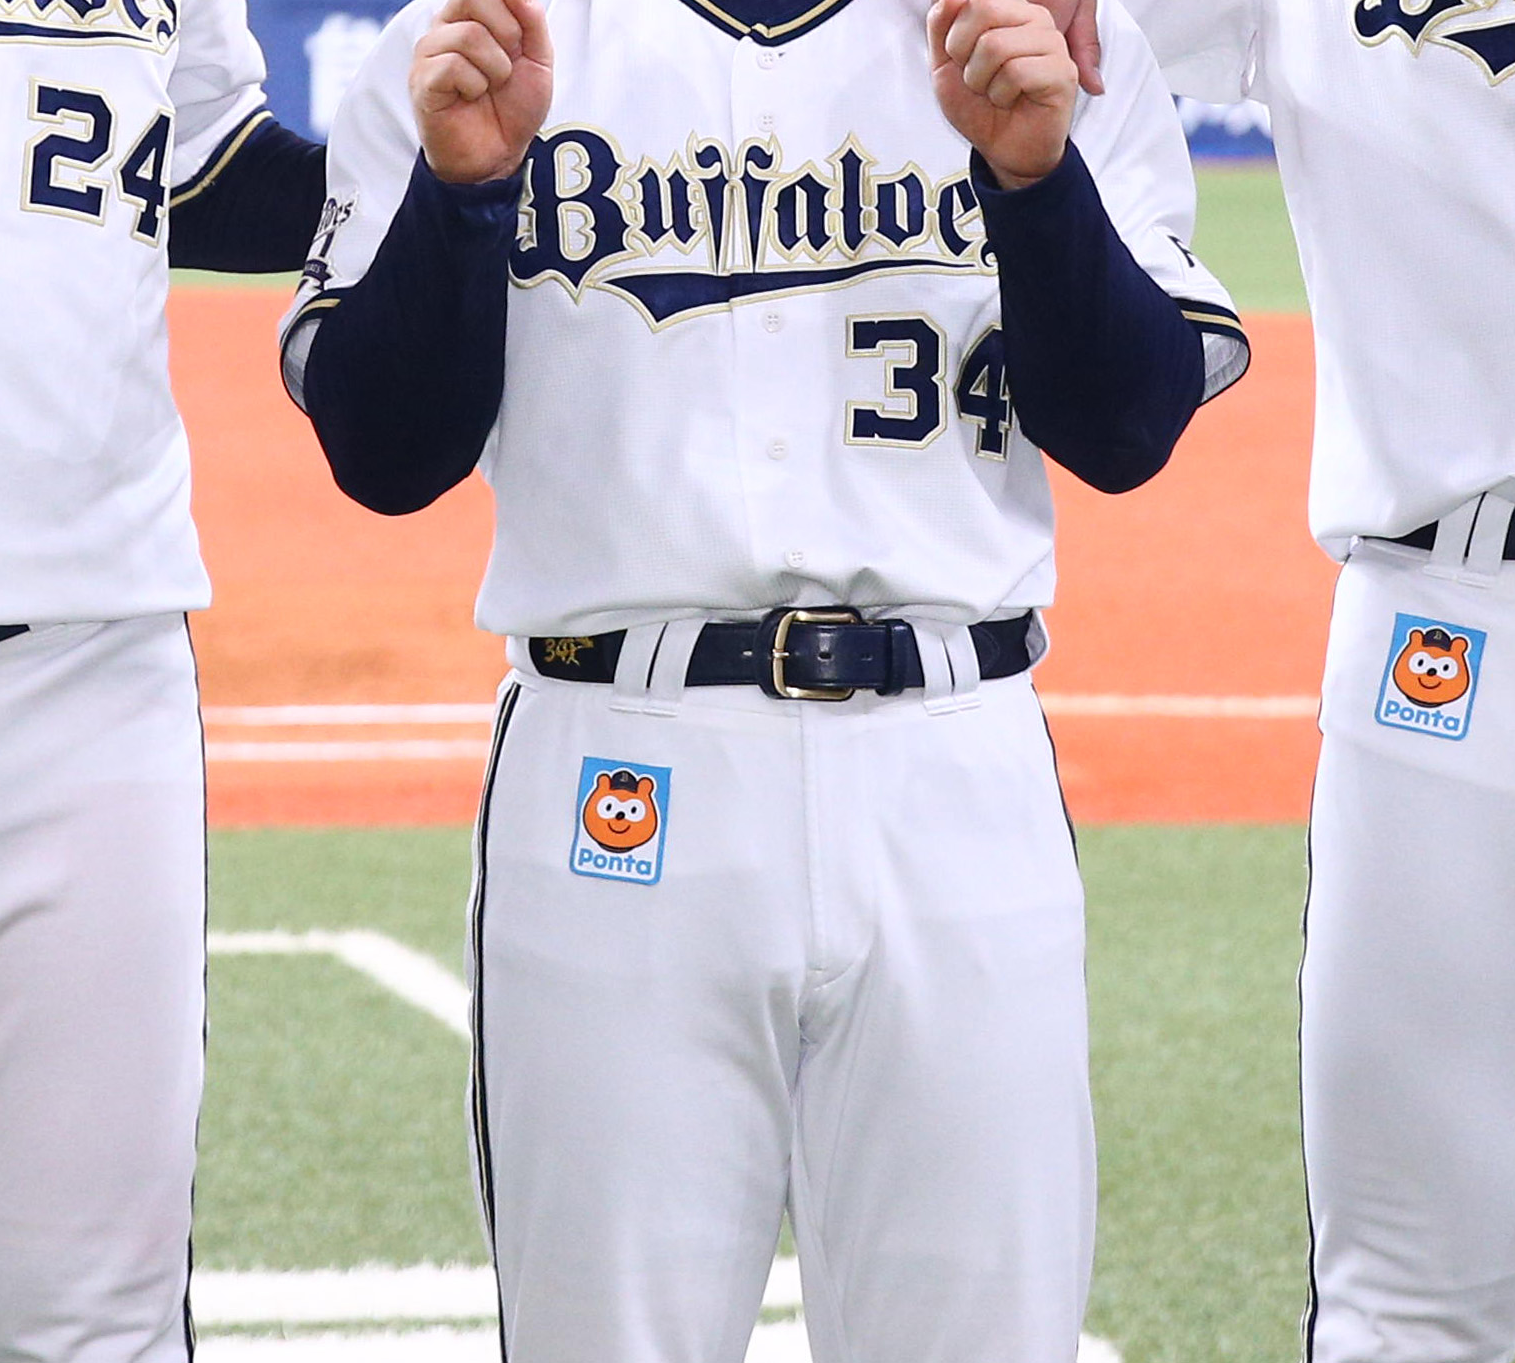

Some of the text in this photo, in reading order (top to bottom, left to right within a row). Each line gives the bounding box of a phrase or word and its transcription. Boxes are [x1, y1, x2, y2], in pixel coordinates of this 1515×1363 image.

[20, 76, 173, 248] 24
[508, 121, 1000, 306] Buffaloe
[844, 312, 1014, 462] 34
[1385, 700, 1460, 731] Ponta
[578, 848, 652, 876] Ponta
